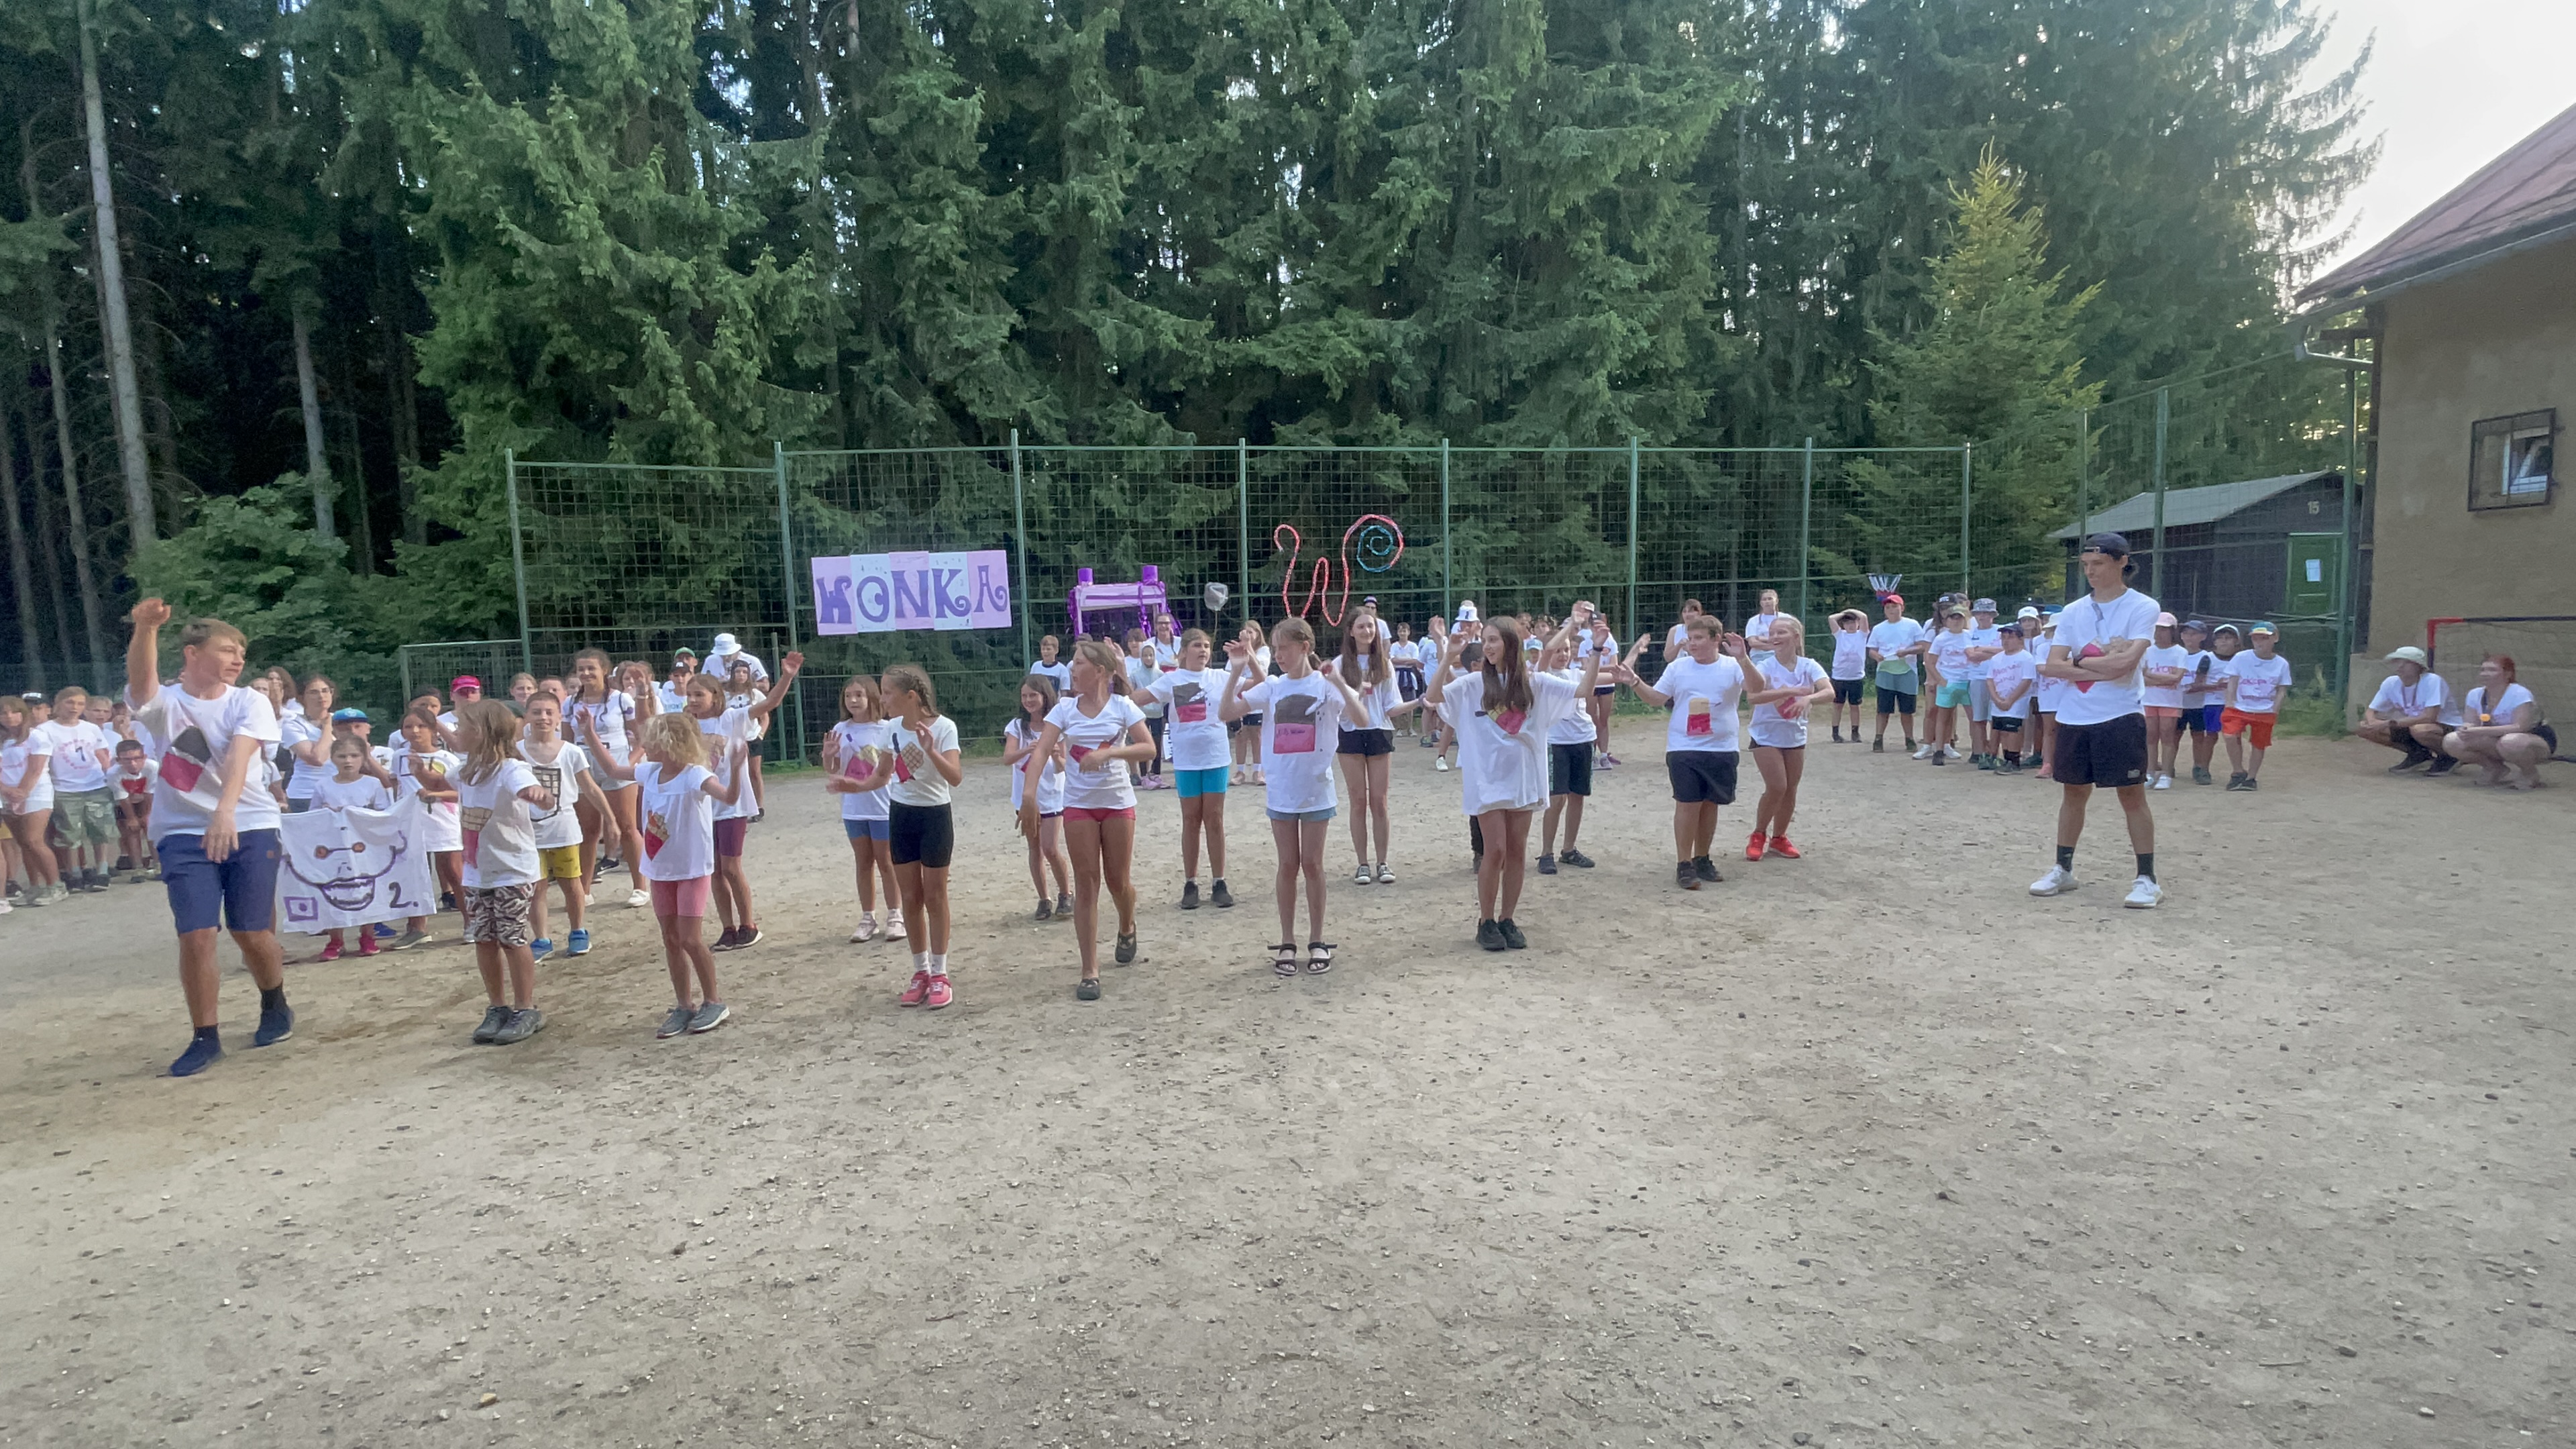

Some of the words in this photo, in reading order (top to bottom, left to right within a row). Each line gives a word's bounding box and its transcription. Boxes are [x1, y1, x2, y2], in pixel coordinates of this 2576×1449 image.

[2308, 501, 2320, 515] 15
[816, 565, 1008, 624] WONKA
[388, 881, 419, 908] 2.
